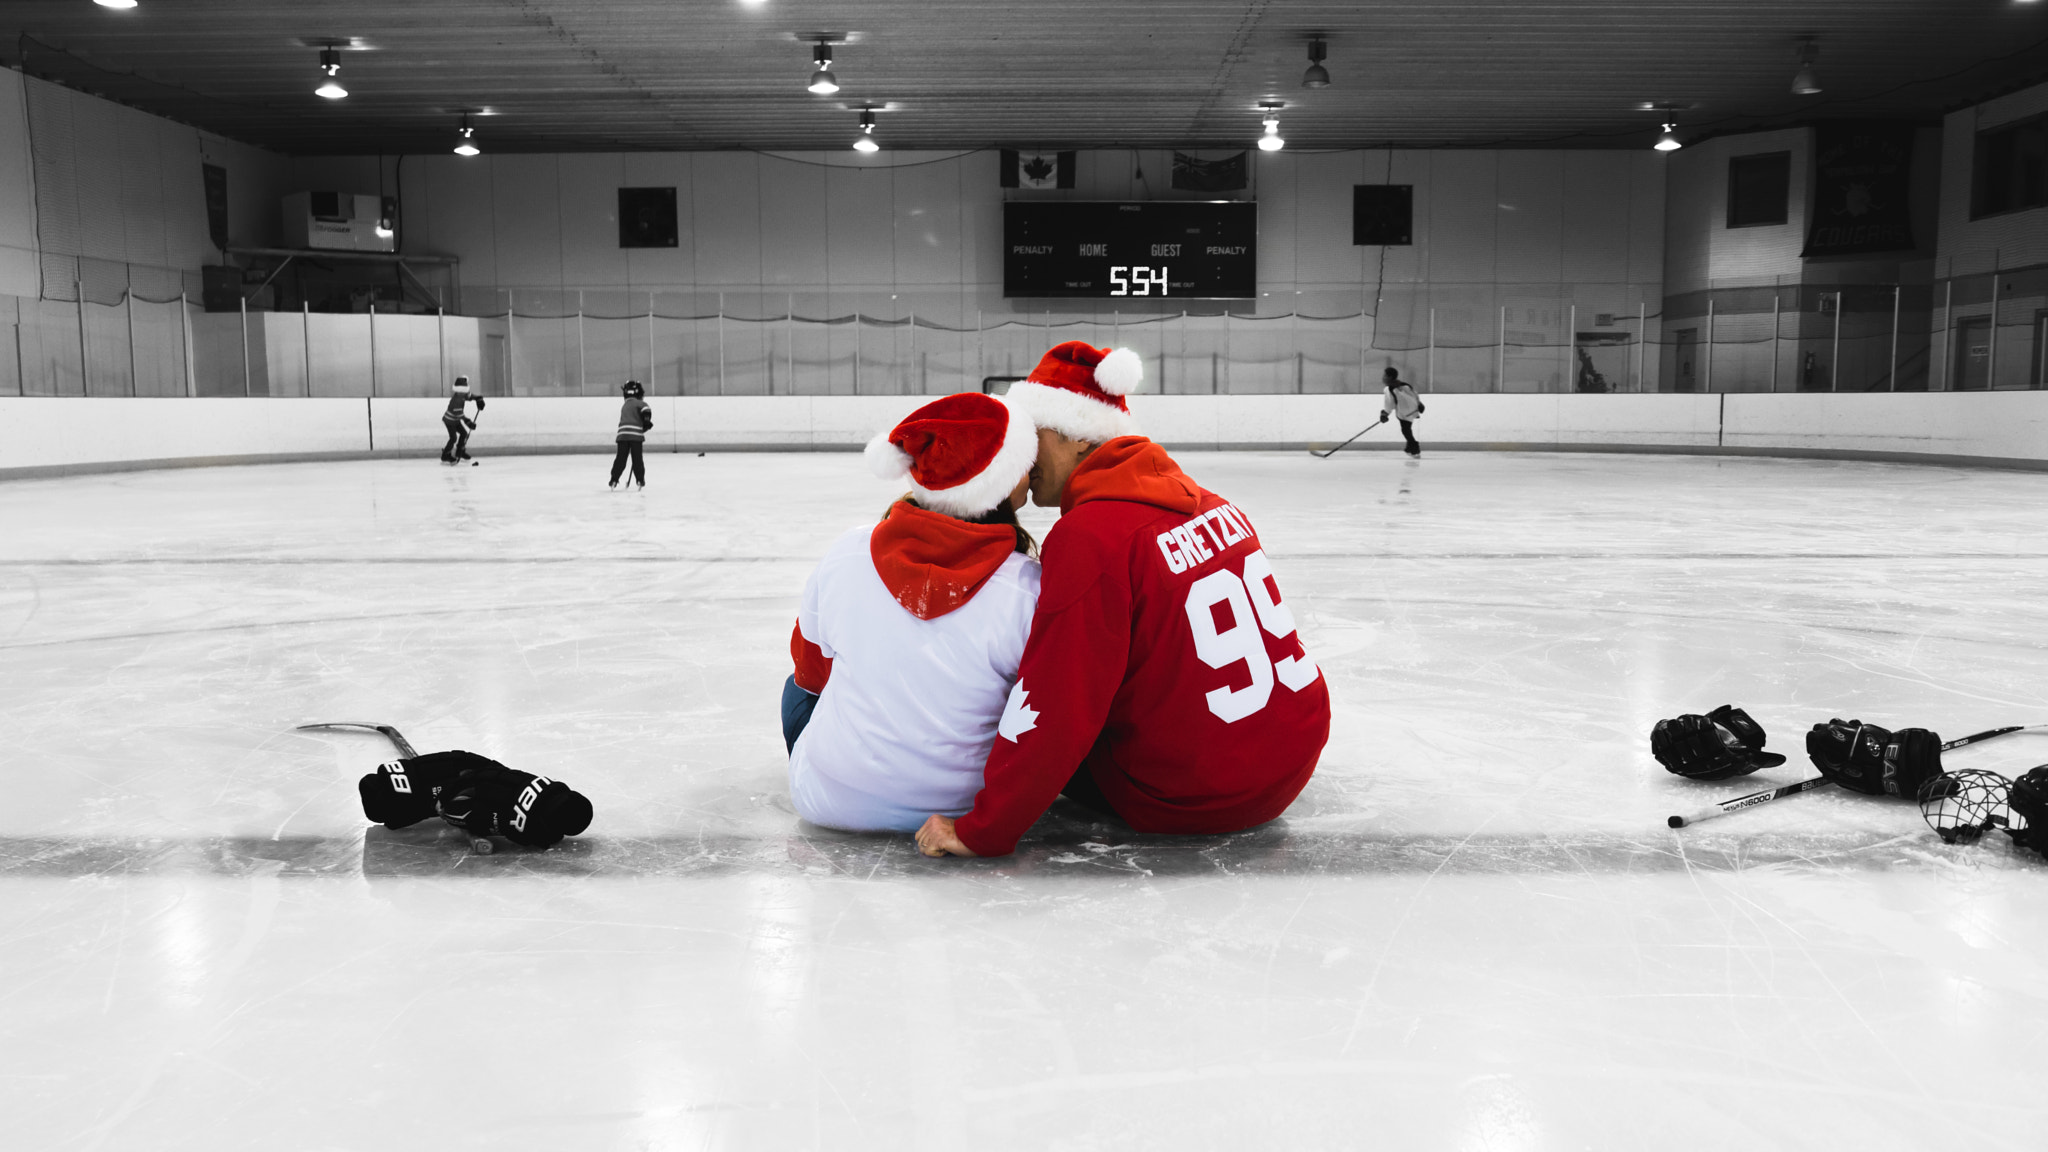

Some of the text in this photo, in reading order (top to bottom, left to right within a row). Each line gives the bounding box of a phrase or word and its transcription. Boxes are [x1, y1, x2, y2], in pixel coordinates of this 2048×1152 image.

[1813, 224, 1906, 248] COUGARS
[1013, 245, 1053, 255] PENALTY
[1079, 243, 1108, 257] HOME
[1151, 243, 1182, 257] GUEST
[1206, 246, 1247, 255] PENALTY
[1156, 503, 1254, 575] GRETZKY
[1184, 548, 1319, 724] 99
